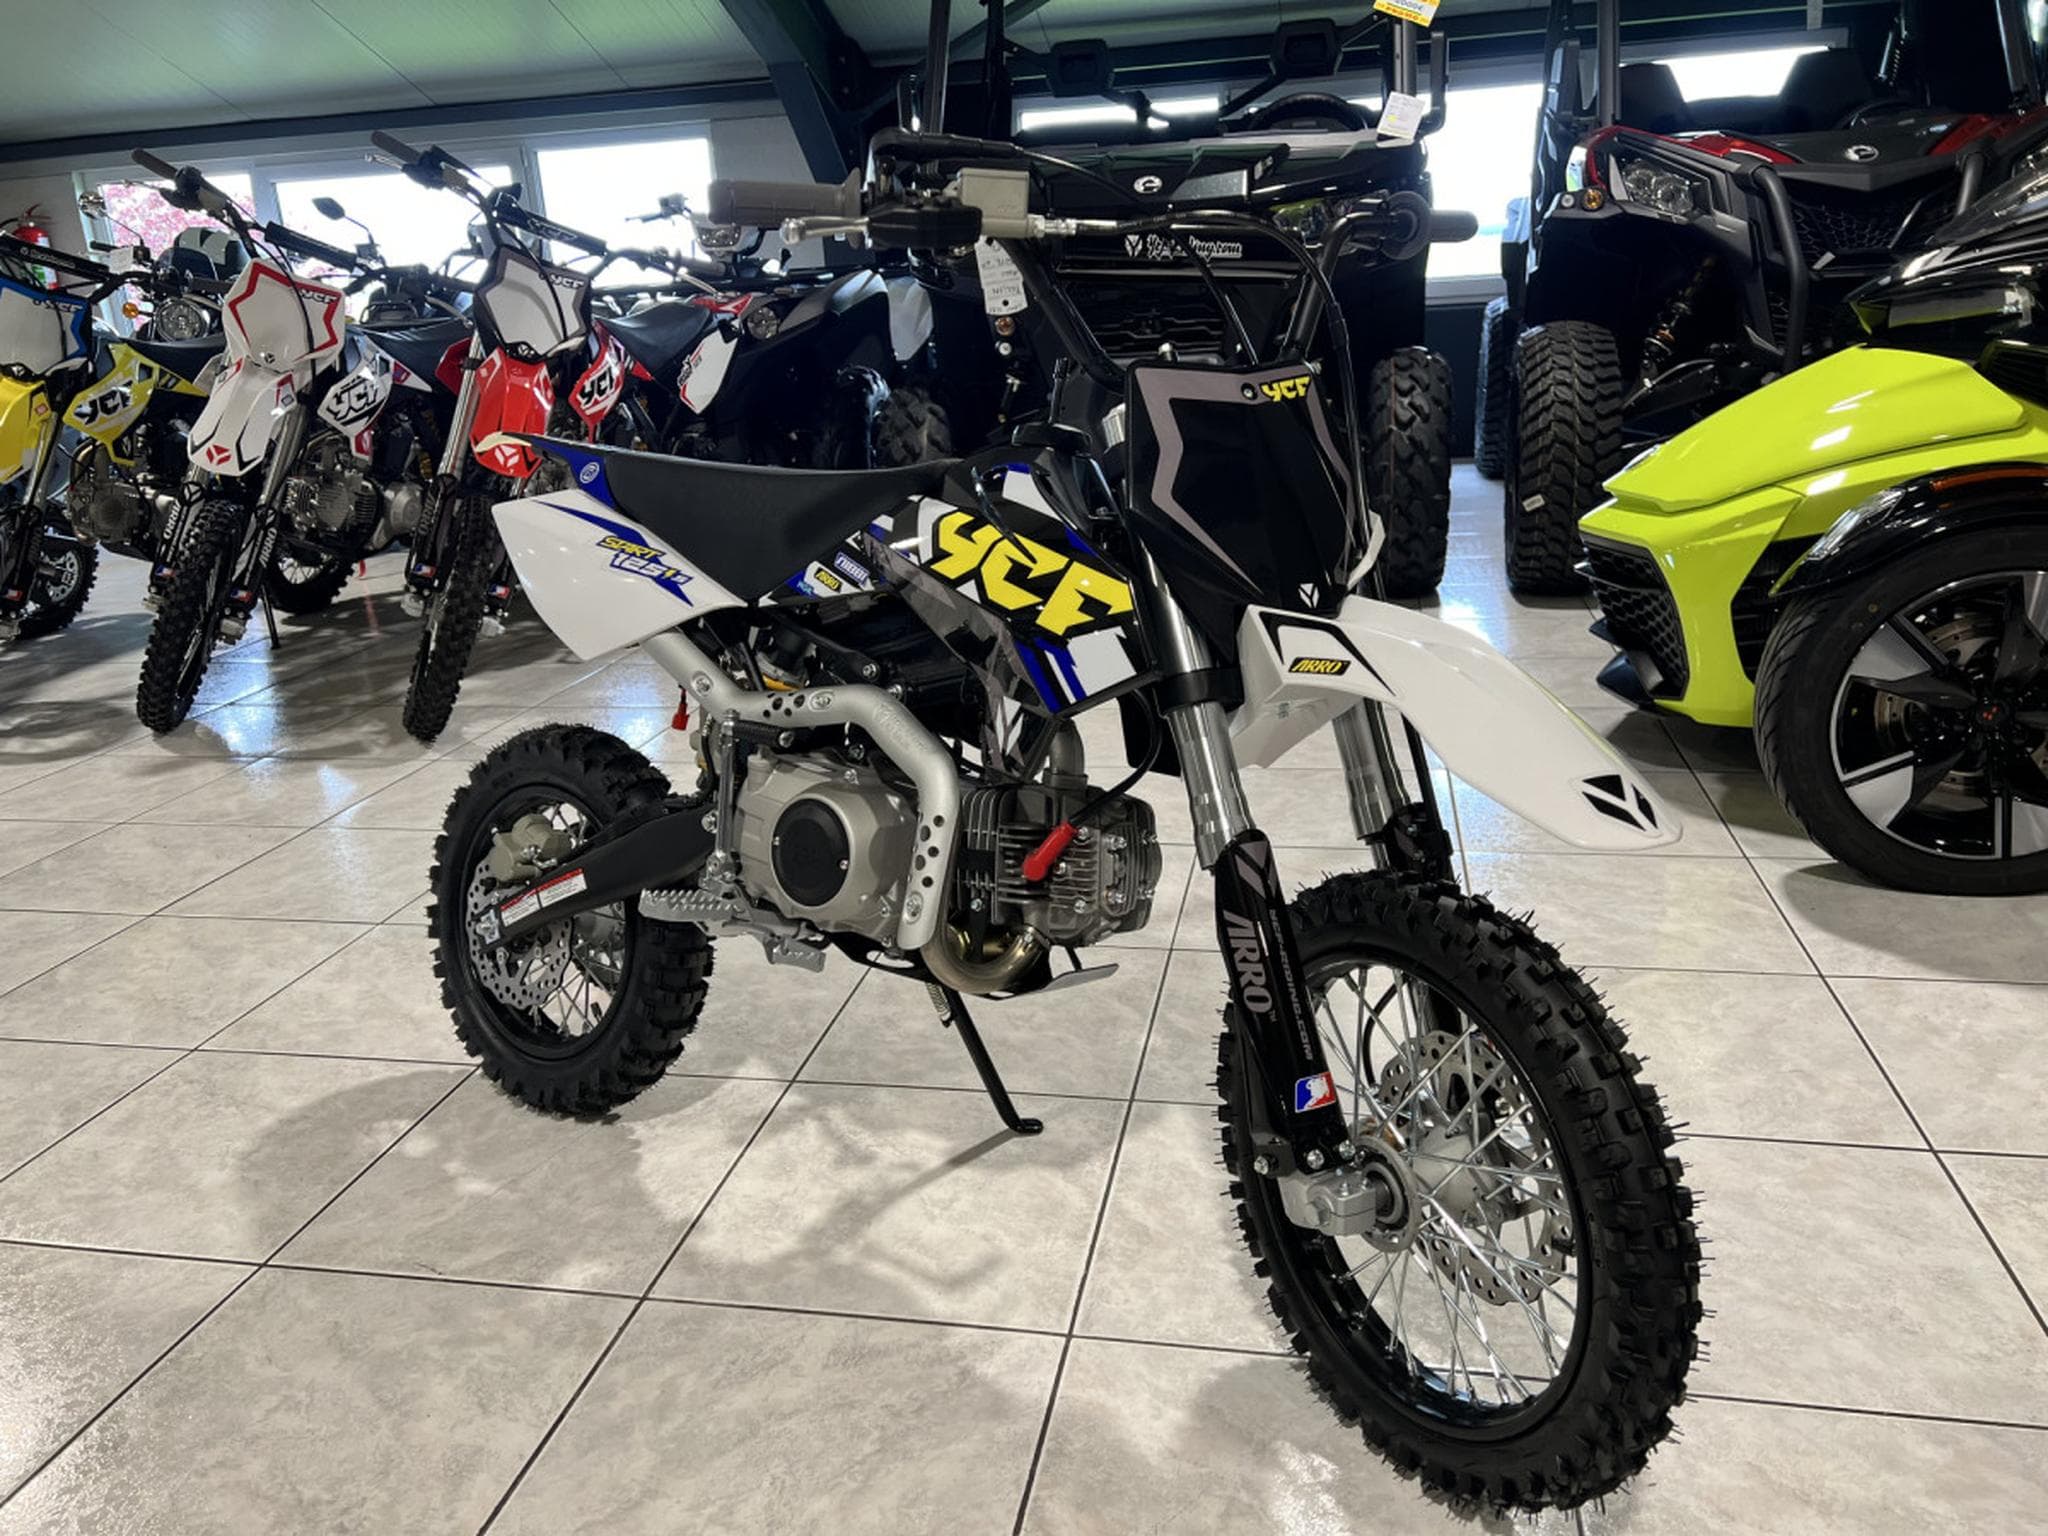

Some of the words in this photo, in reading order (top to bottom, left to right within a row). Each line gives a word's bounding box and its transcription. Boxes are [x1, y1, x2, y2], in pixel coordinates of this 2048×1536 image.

[1260, 375, 1311, 403] YCF
[929, 510, 1136, 637] YCF
[1290, 659, 1343, 674] ARRO
